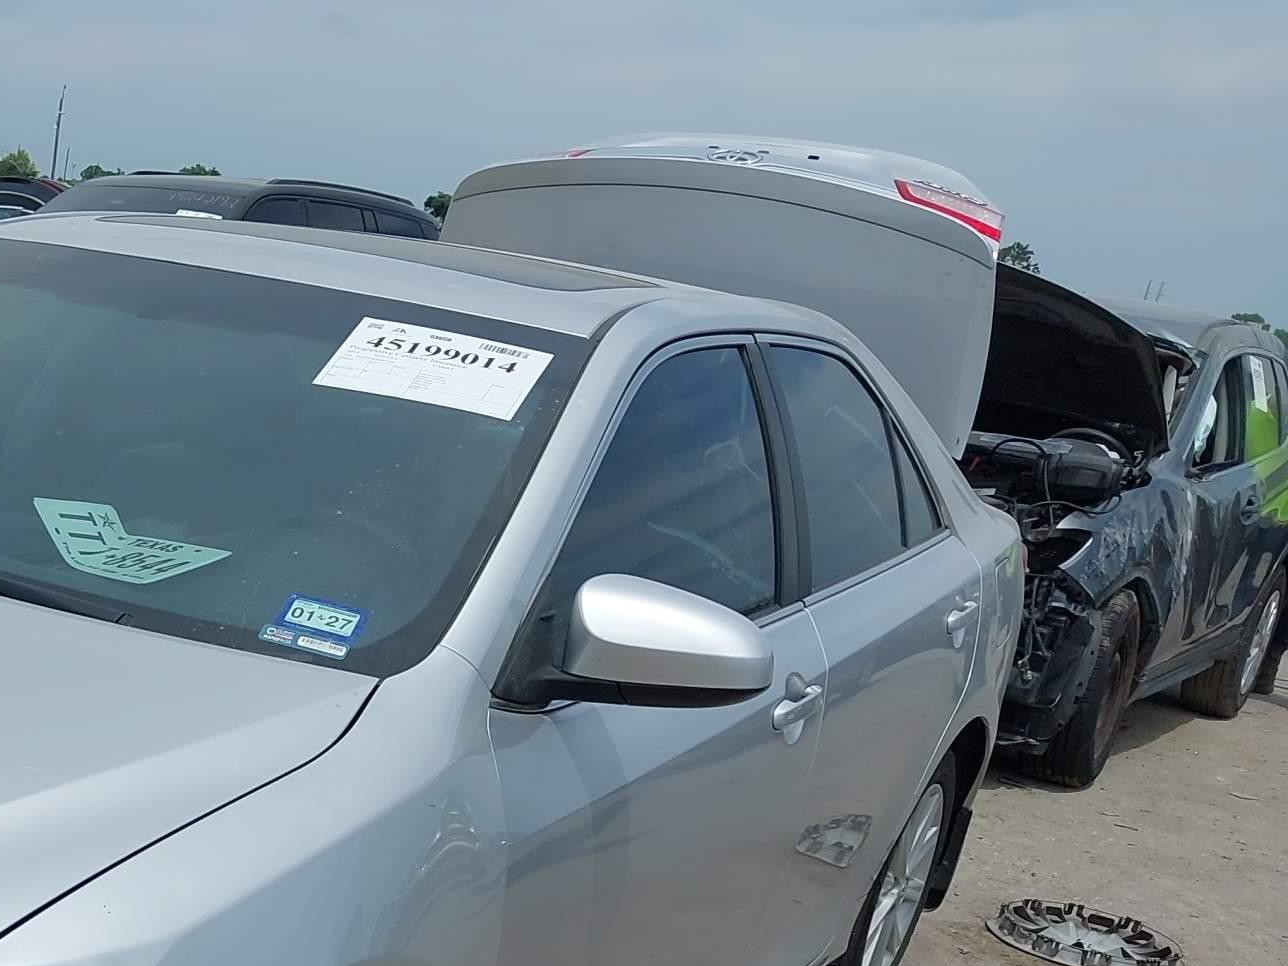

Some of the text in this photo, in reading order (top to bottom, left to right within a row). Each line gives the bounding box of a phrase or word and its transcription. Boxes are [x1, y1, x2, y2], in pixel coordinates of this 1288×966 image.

[366, 336, 518, 374] 45199014
[127, 538, 184, 553] TEXAS
[291, 606, 315, 622] 01
[325, 615, 354, 631] 27
